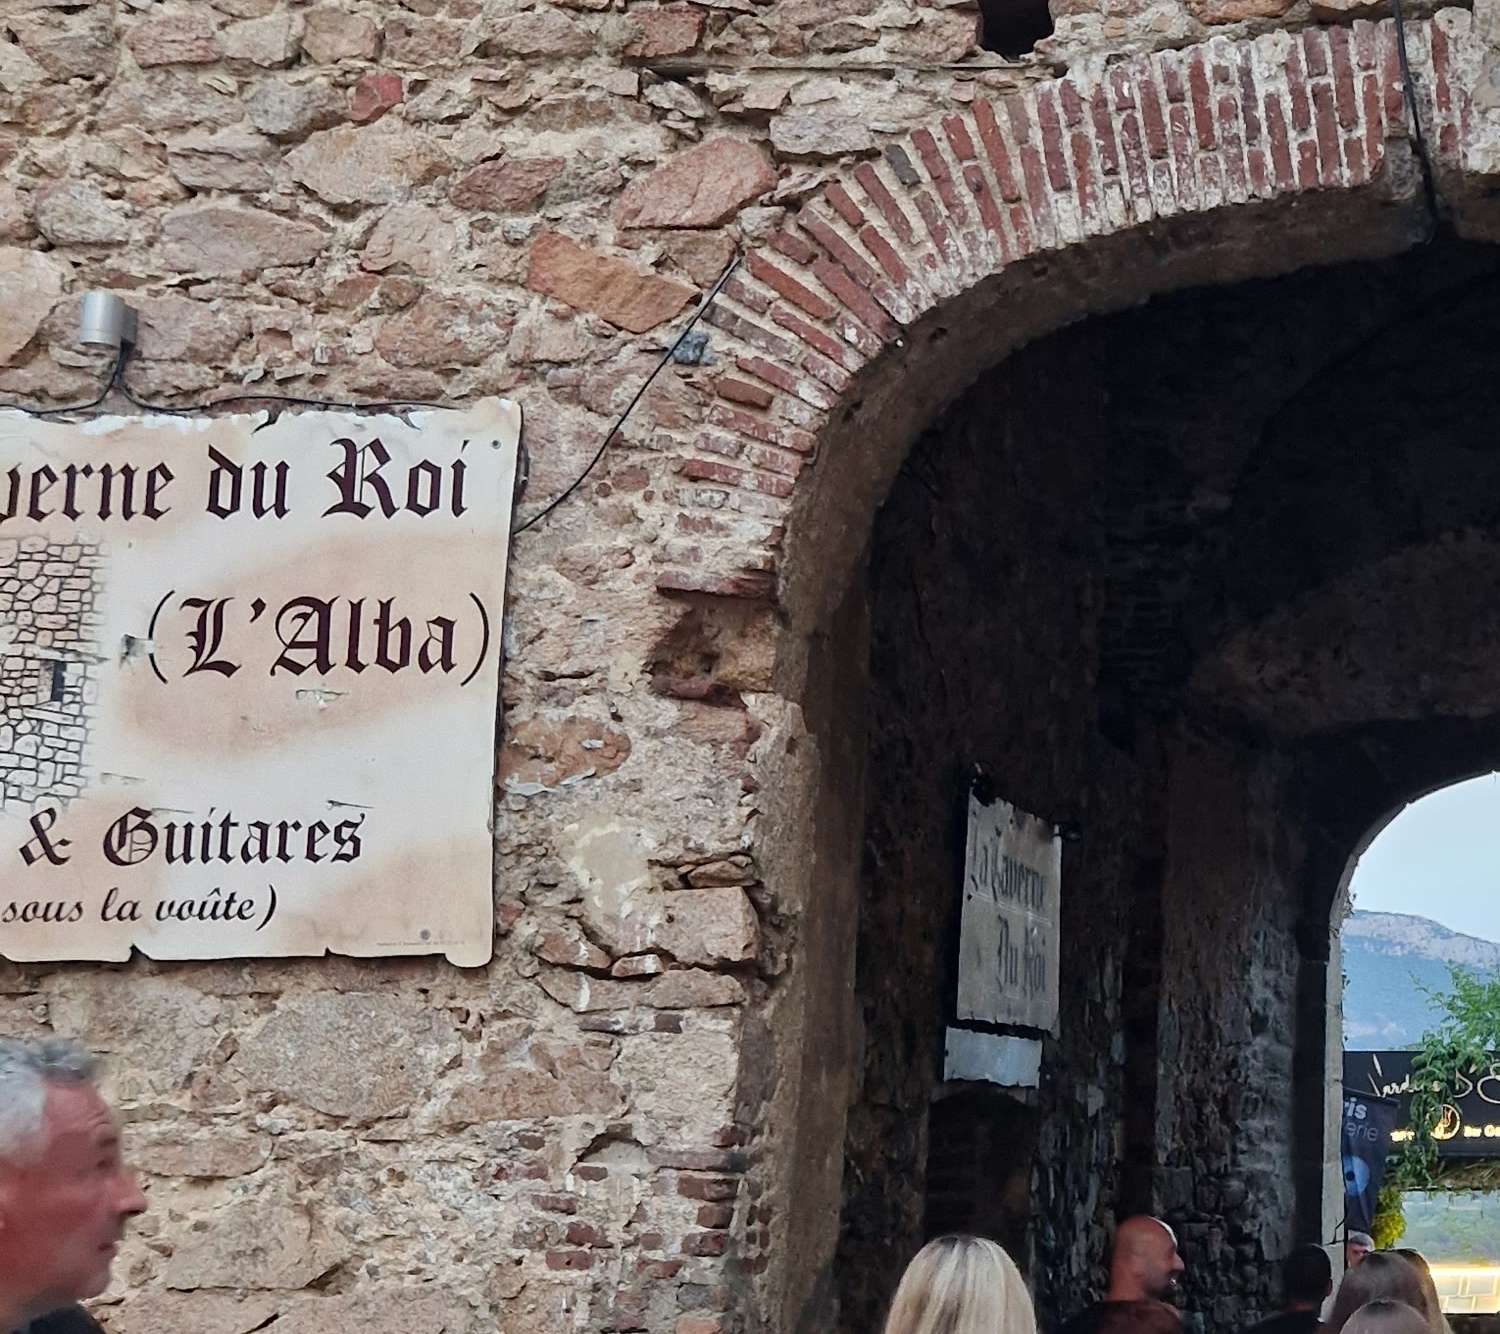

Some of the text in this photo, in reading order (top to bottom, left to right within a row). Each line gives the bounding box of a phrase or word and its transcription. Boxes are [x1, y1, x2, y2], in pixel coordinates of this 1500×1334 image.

[206, 444, 290, 521] du
[322, 438, 470, 520] Roi
[18, 806, 364, 867] & Guitares
[100, 886, 142, 922] la
[155, 884, 278, 932] voûte)
